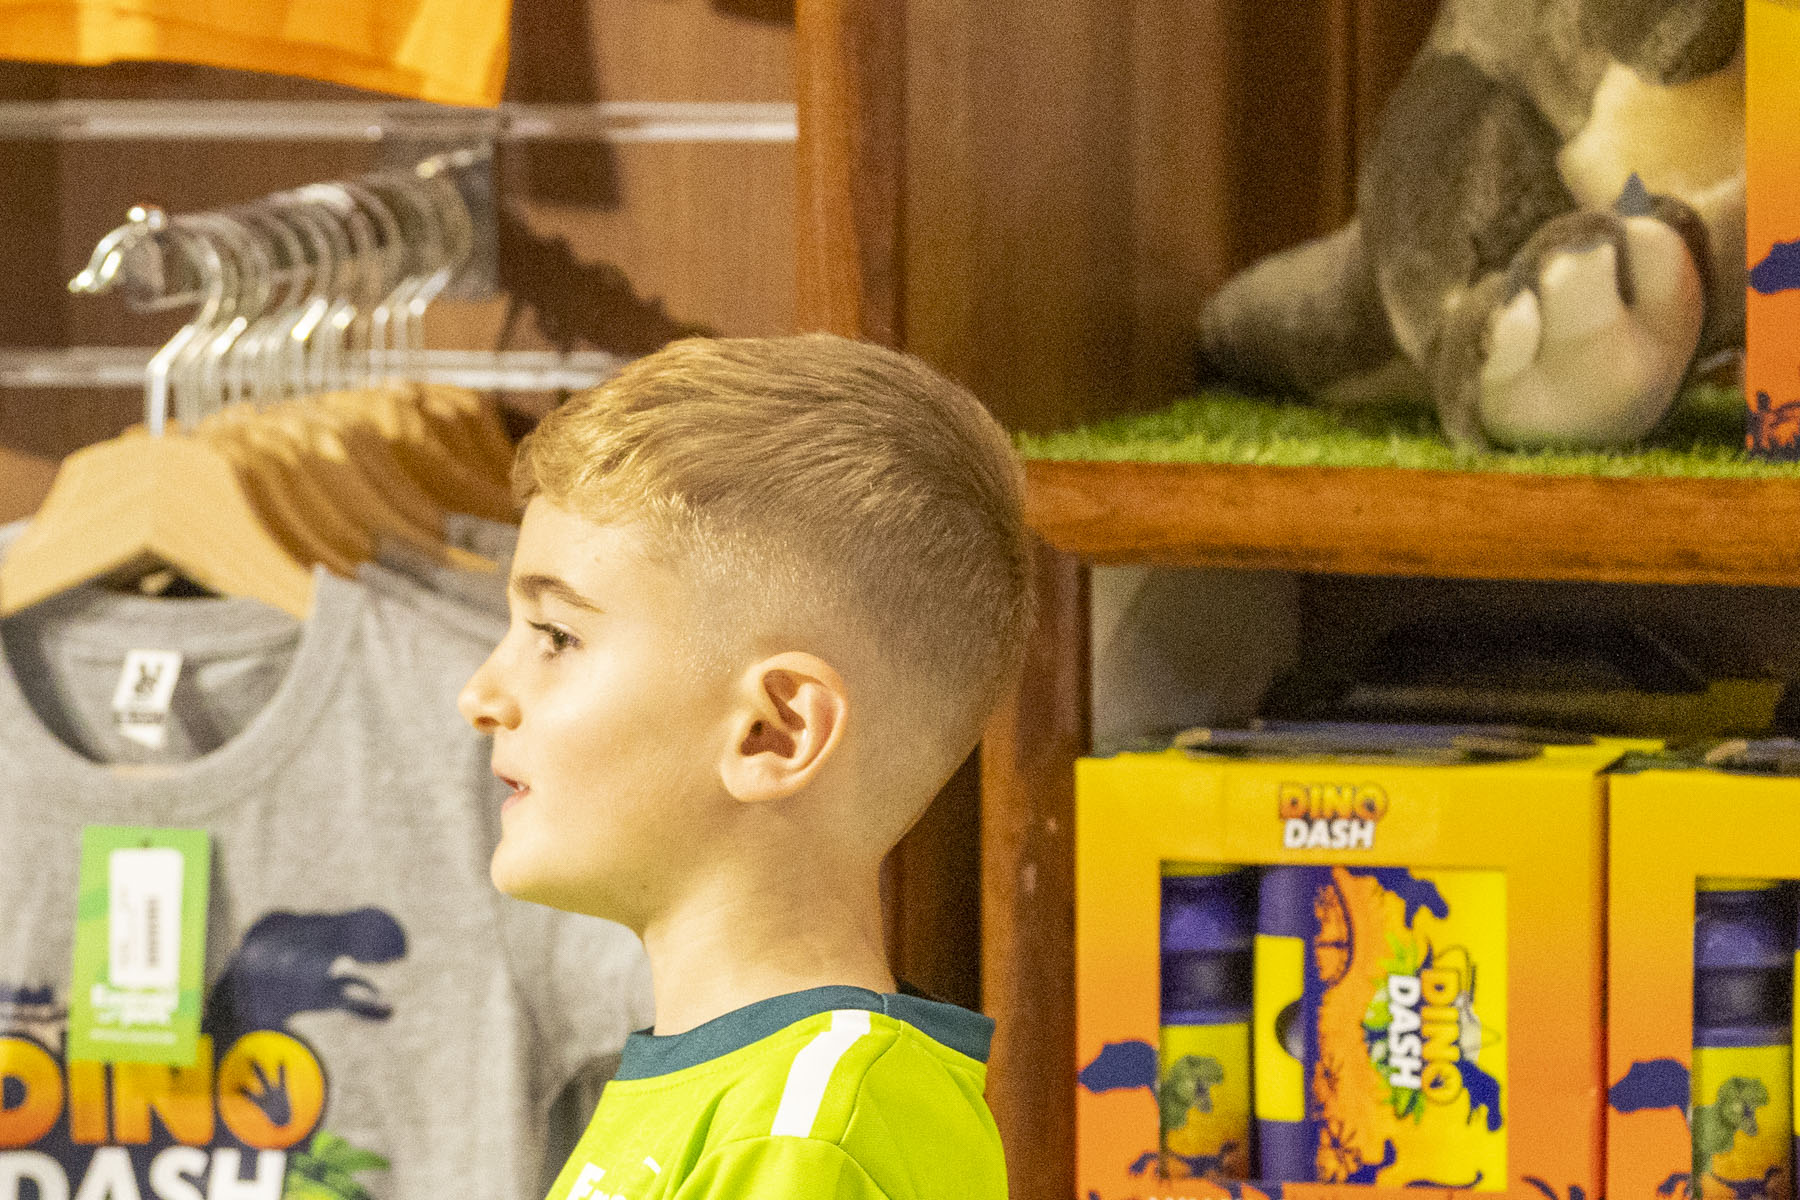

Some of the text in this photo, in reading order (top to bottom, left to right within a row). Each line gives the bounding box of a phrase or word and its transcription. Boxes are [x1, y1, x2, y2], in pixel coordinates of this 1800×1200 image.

[1280, 781, 1388, 821] DINO
[1284, 818, 1375, 849] DASH
[1387, 974, 1422, 1089] DASH
[1421, 968, 1463, 1104] DINO
